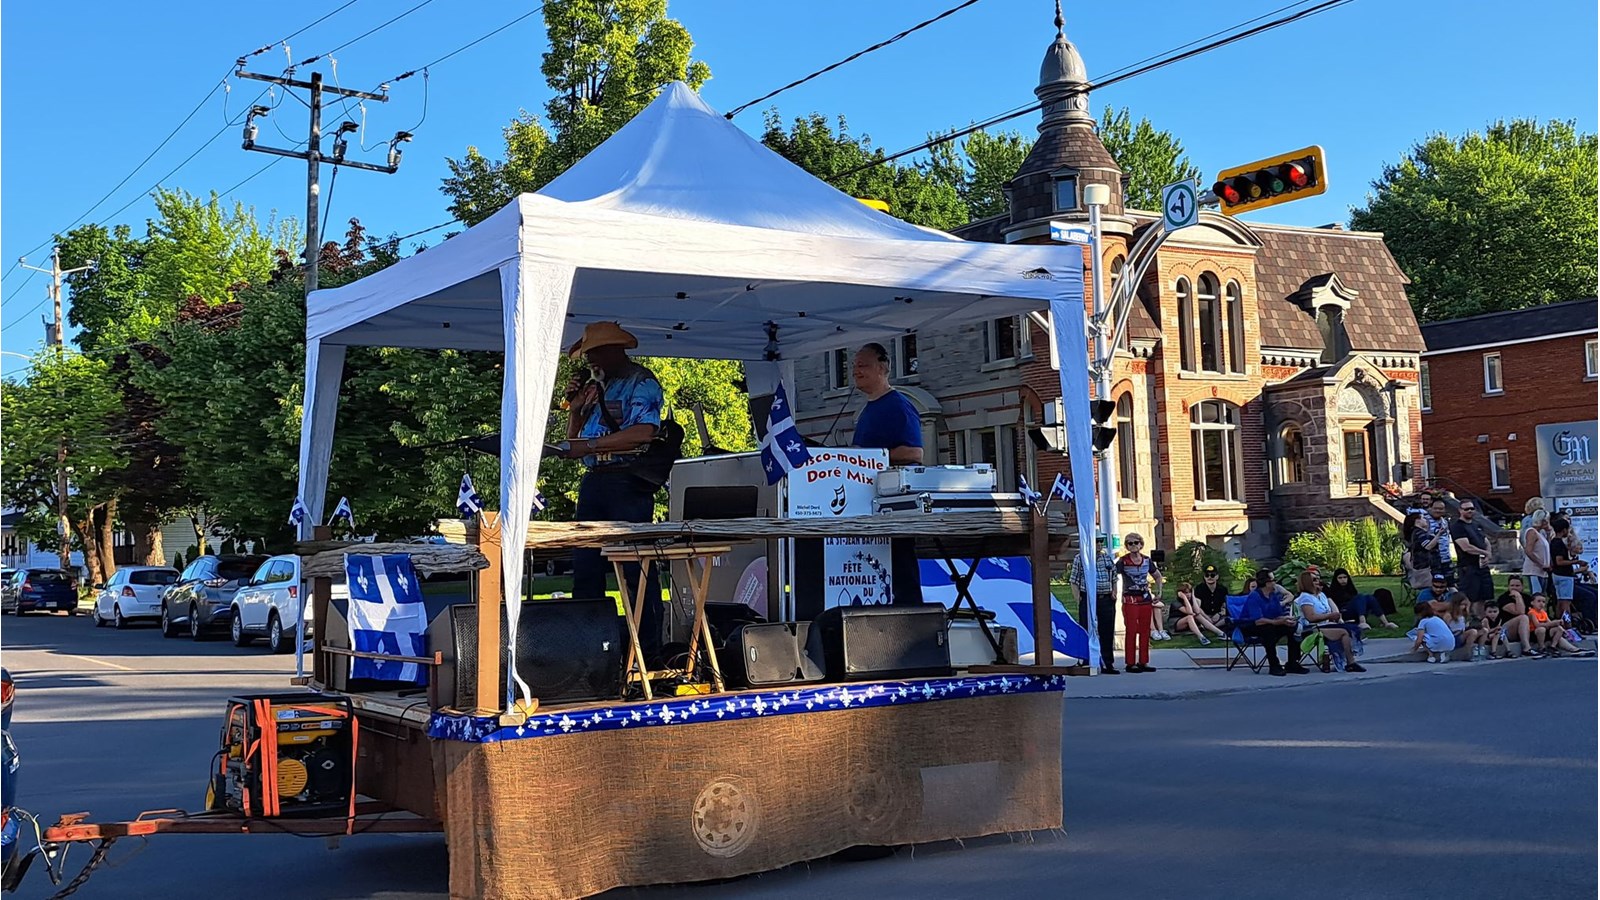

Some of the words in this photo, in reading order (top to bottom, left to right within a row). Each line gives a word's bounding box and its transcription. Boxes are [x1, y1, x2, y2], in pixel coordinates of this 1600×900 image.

[795, 453, 884, 470] isco-mobile
[807, 467, 842, 483] Doré
[847, 469, 874, 485] Mix
[843, 560, 862, 573] FÊTE
[828, 575, 877, 586] NATIONALE
[863, 587, 874, 597] DU
